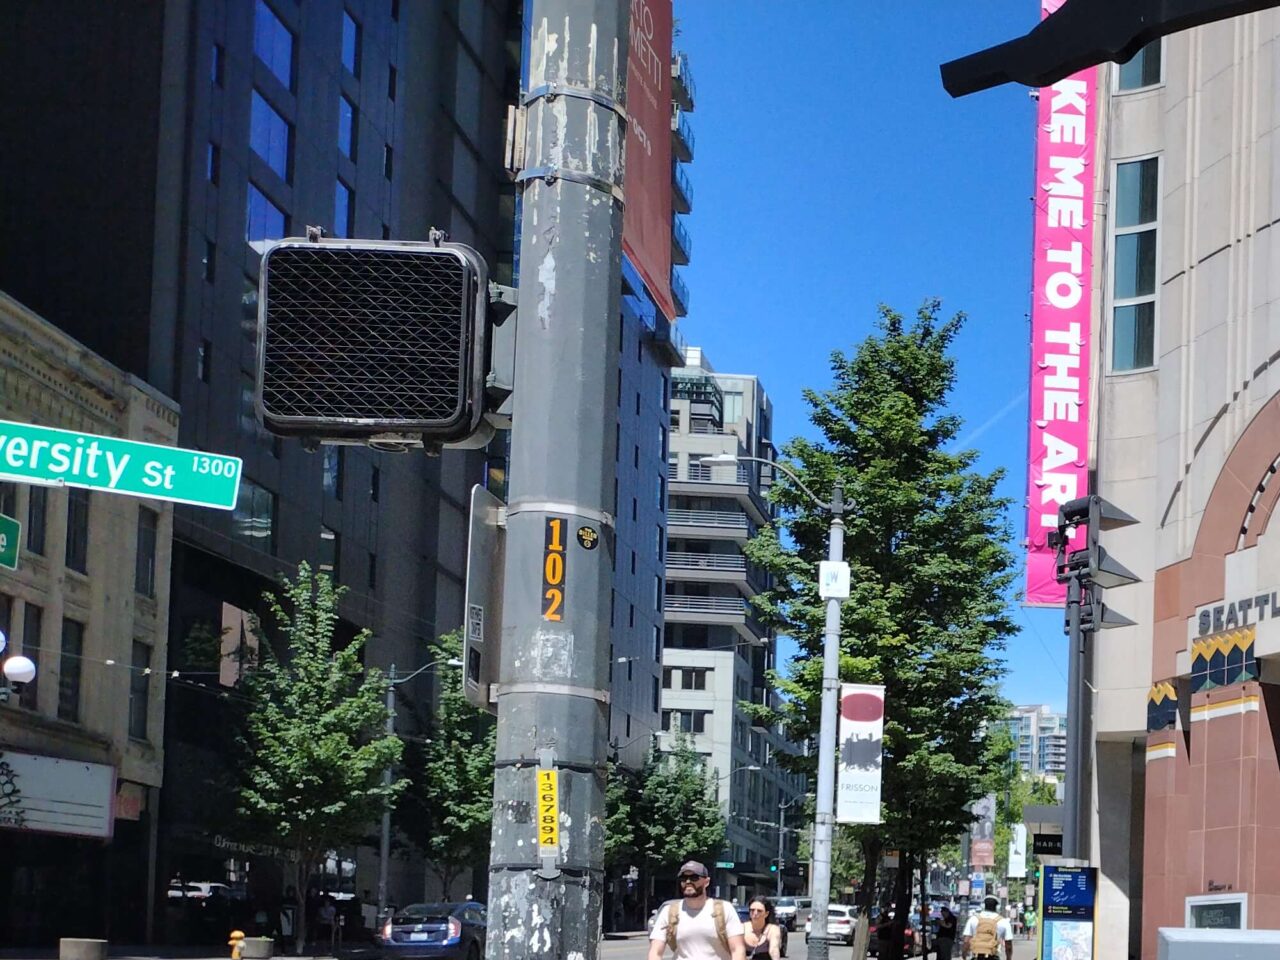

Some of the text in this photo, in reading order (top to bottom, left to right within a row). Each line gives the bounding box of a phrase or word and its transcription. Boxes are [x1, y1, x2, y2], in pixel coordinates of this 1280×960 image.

[1047, 155, 1085, 230] ME
[1045, 241, 1083, 309] TO
[1043, 322, 1080, 422] THE
[142, 461, 176, 490] St
[192, 456, 236, 479] 1300
[544, 518, 563, 621] 102
[541, 772, 556, 845] 1367894
[841, 783, 879, 792] FRISSON
